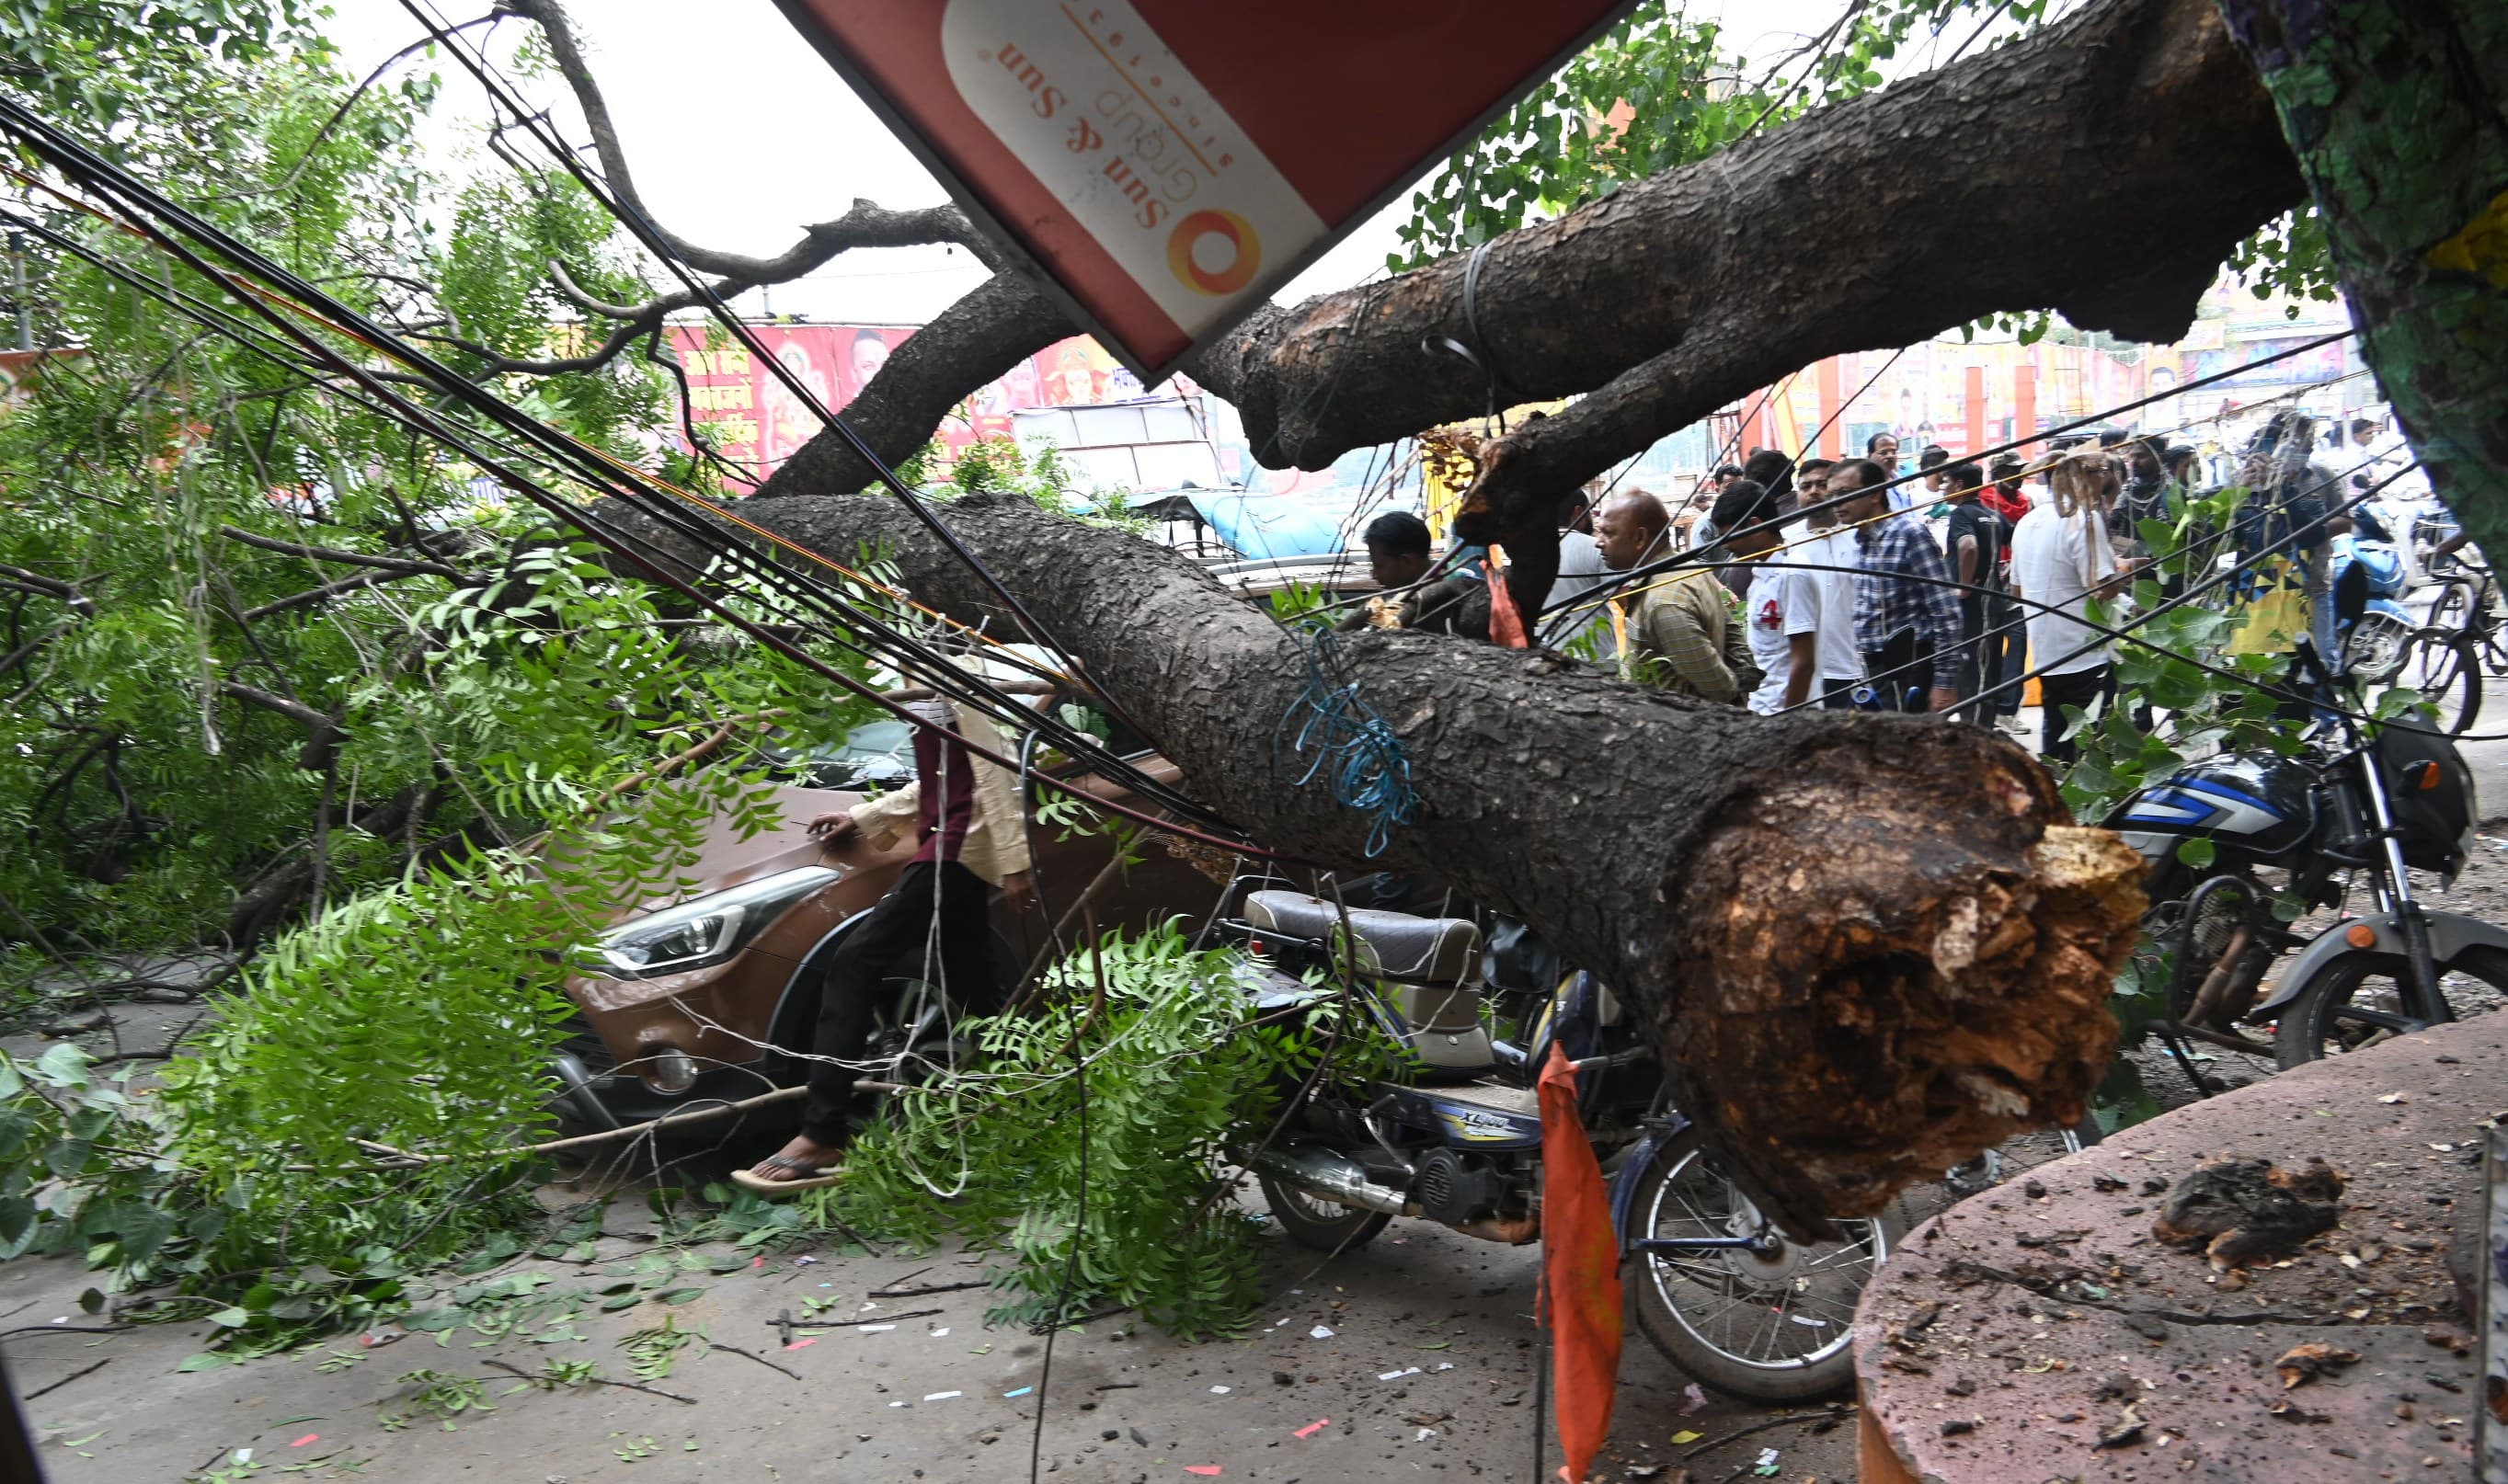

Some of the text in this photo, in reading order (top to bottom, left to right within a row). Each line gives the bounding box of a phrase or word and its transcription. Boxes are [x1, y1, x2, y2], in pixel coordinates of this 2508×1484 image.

[1074, 0, 1140, 68] 193
[996, 40, 1170, 229] Sun & Sun
[1095, 88, 1198, 203] Group
